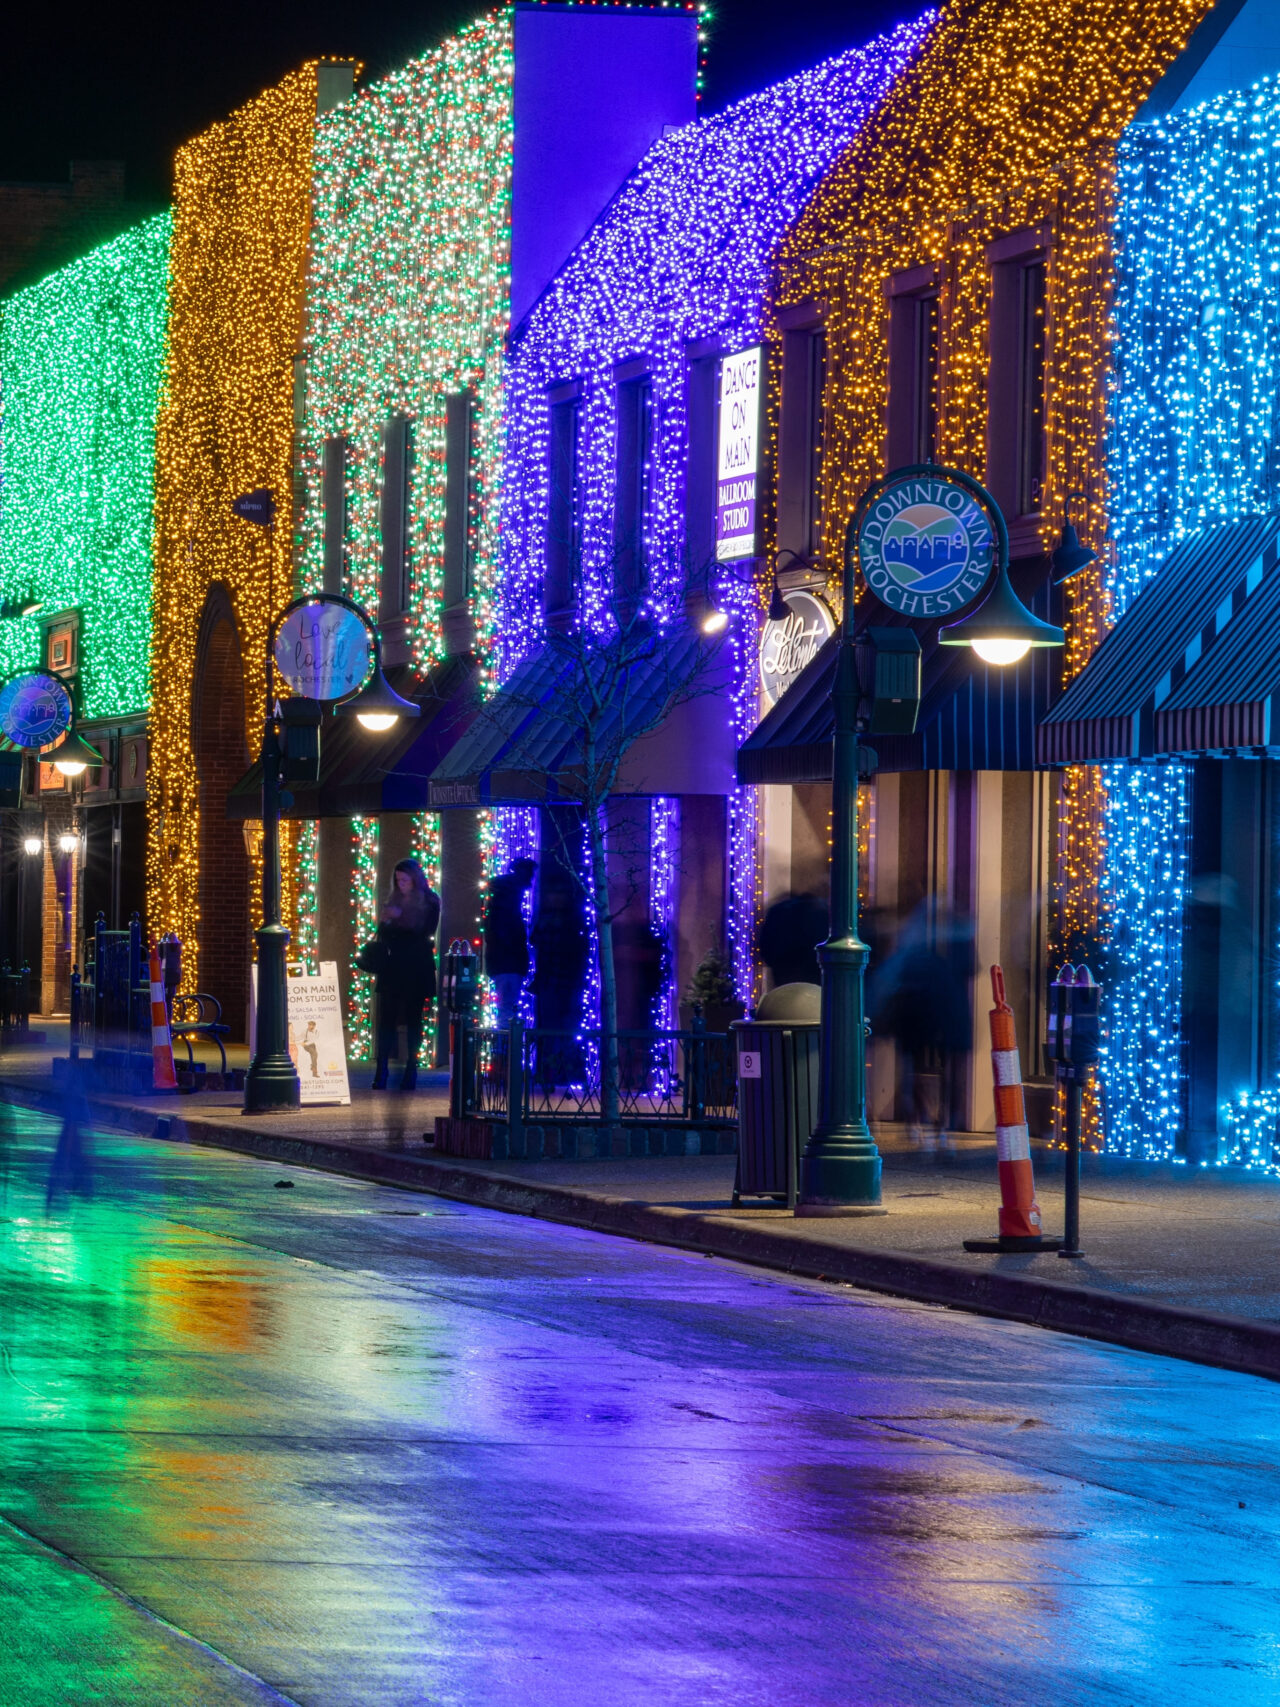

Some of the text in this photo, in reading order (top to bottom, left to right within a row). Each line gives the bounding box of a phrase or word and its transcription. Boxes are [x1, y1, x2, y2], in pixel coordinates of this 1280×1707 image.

[725, 359, 757, 396] DANCE
[732, 399, 748, 431] ON
[725, 435, 751, 469] MAIN
[719, 479, 756, 507] BALLROOM
[723, 506, 750, 532] STUDIO
[863, 483, 990, 548] DOWNTOWN
[862, 553, 990, 615] ROCHESTER
[300, 613, 342, 639] Love
[295, 641, 347, 670] local
[0, 675, 67, 711] DOWNTOWN
[0, 712, 66, 746] ROCHESTER
[293, 986, 308, 994] ON
[310, 985, 335, 994] MAIN
[305, 995, 337, 1003] STUDIO
